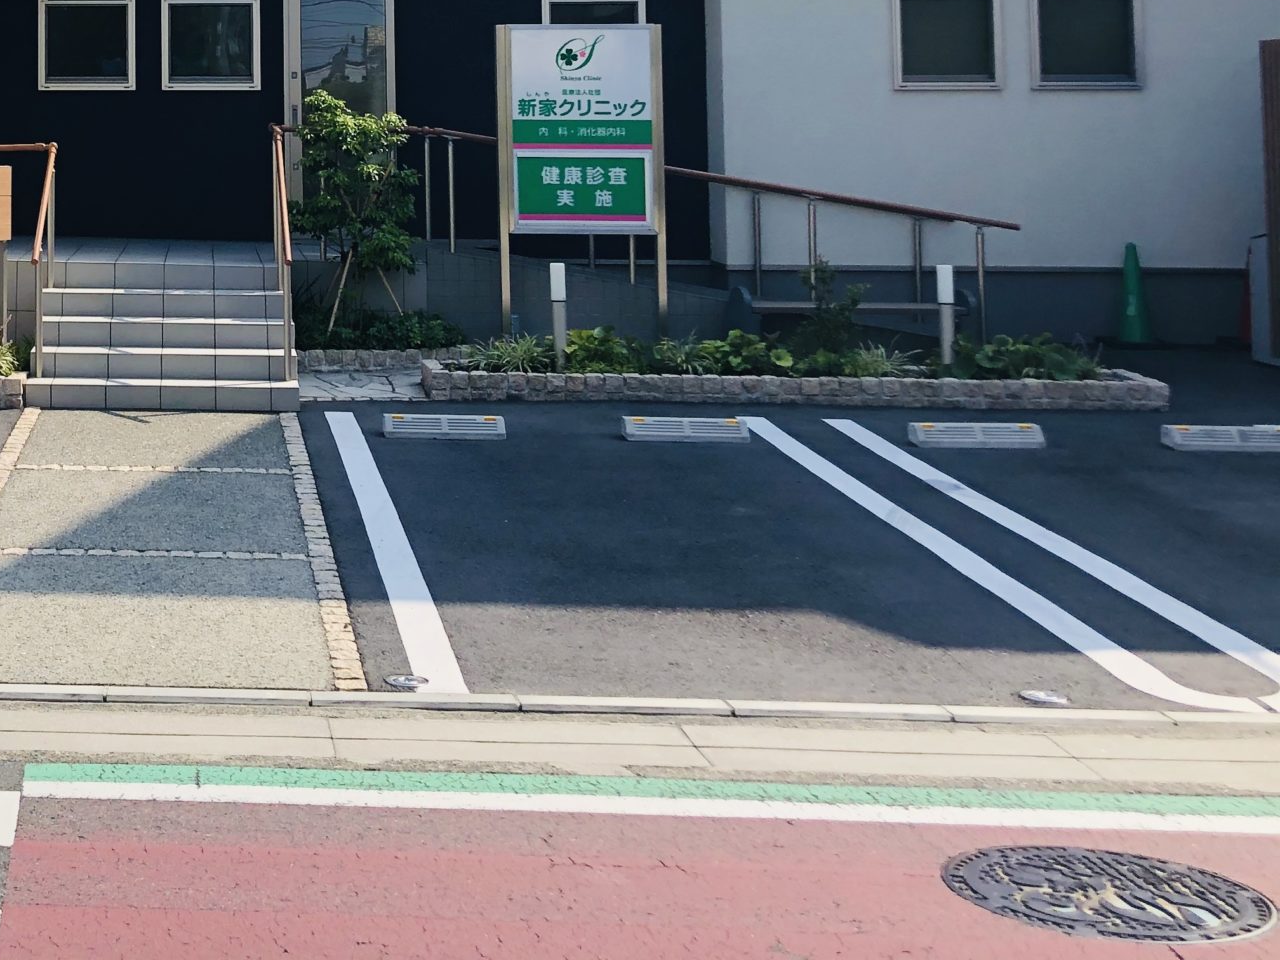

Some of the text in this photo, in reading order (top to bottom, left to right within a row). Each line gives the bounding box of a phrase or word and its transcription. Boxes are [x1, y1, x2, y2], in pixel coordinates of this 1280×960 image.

[518, 98, 647, 117] 新家クリニック
[541, 166, 628, 185] 健康診査
